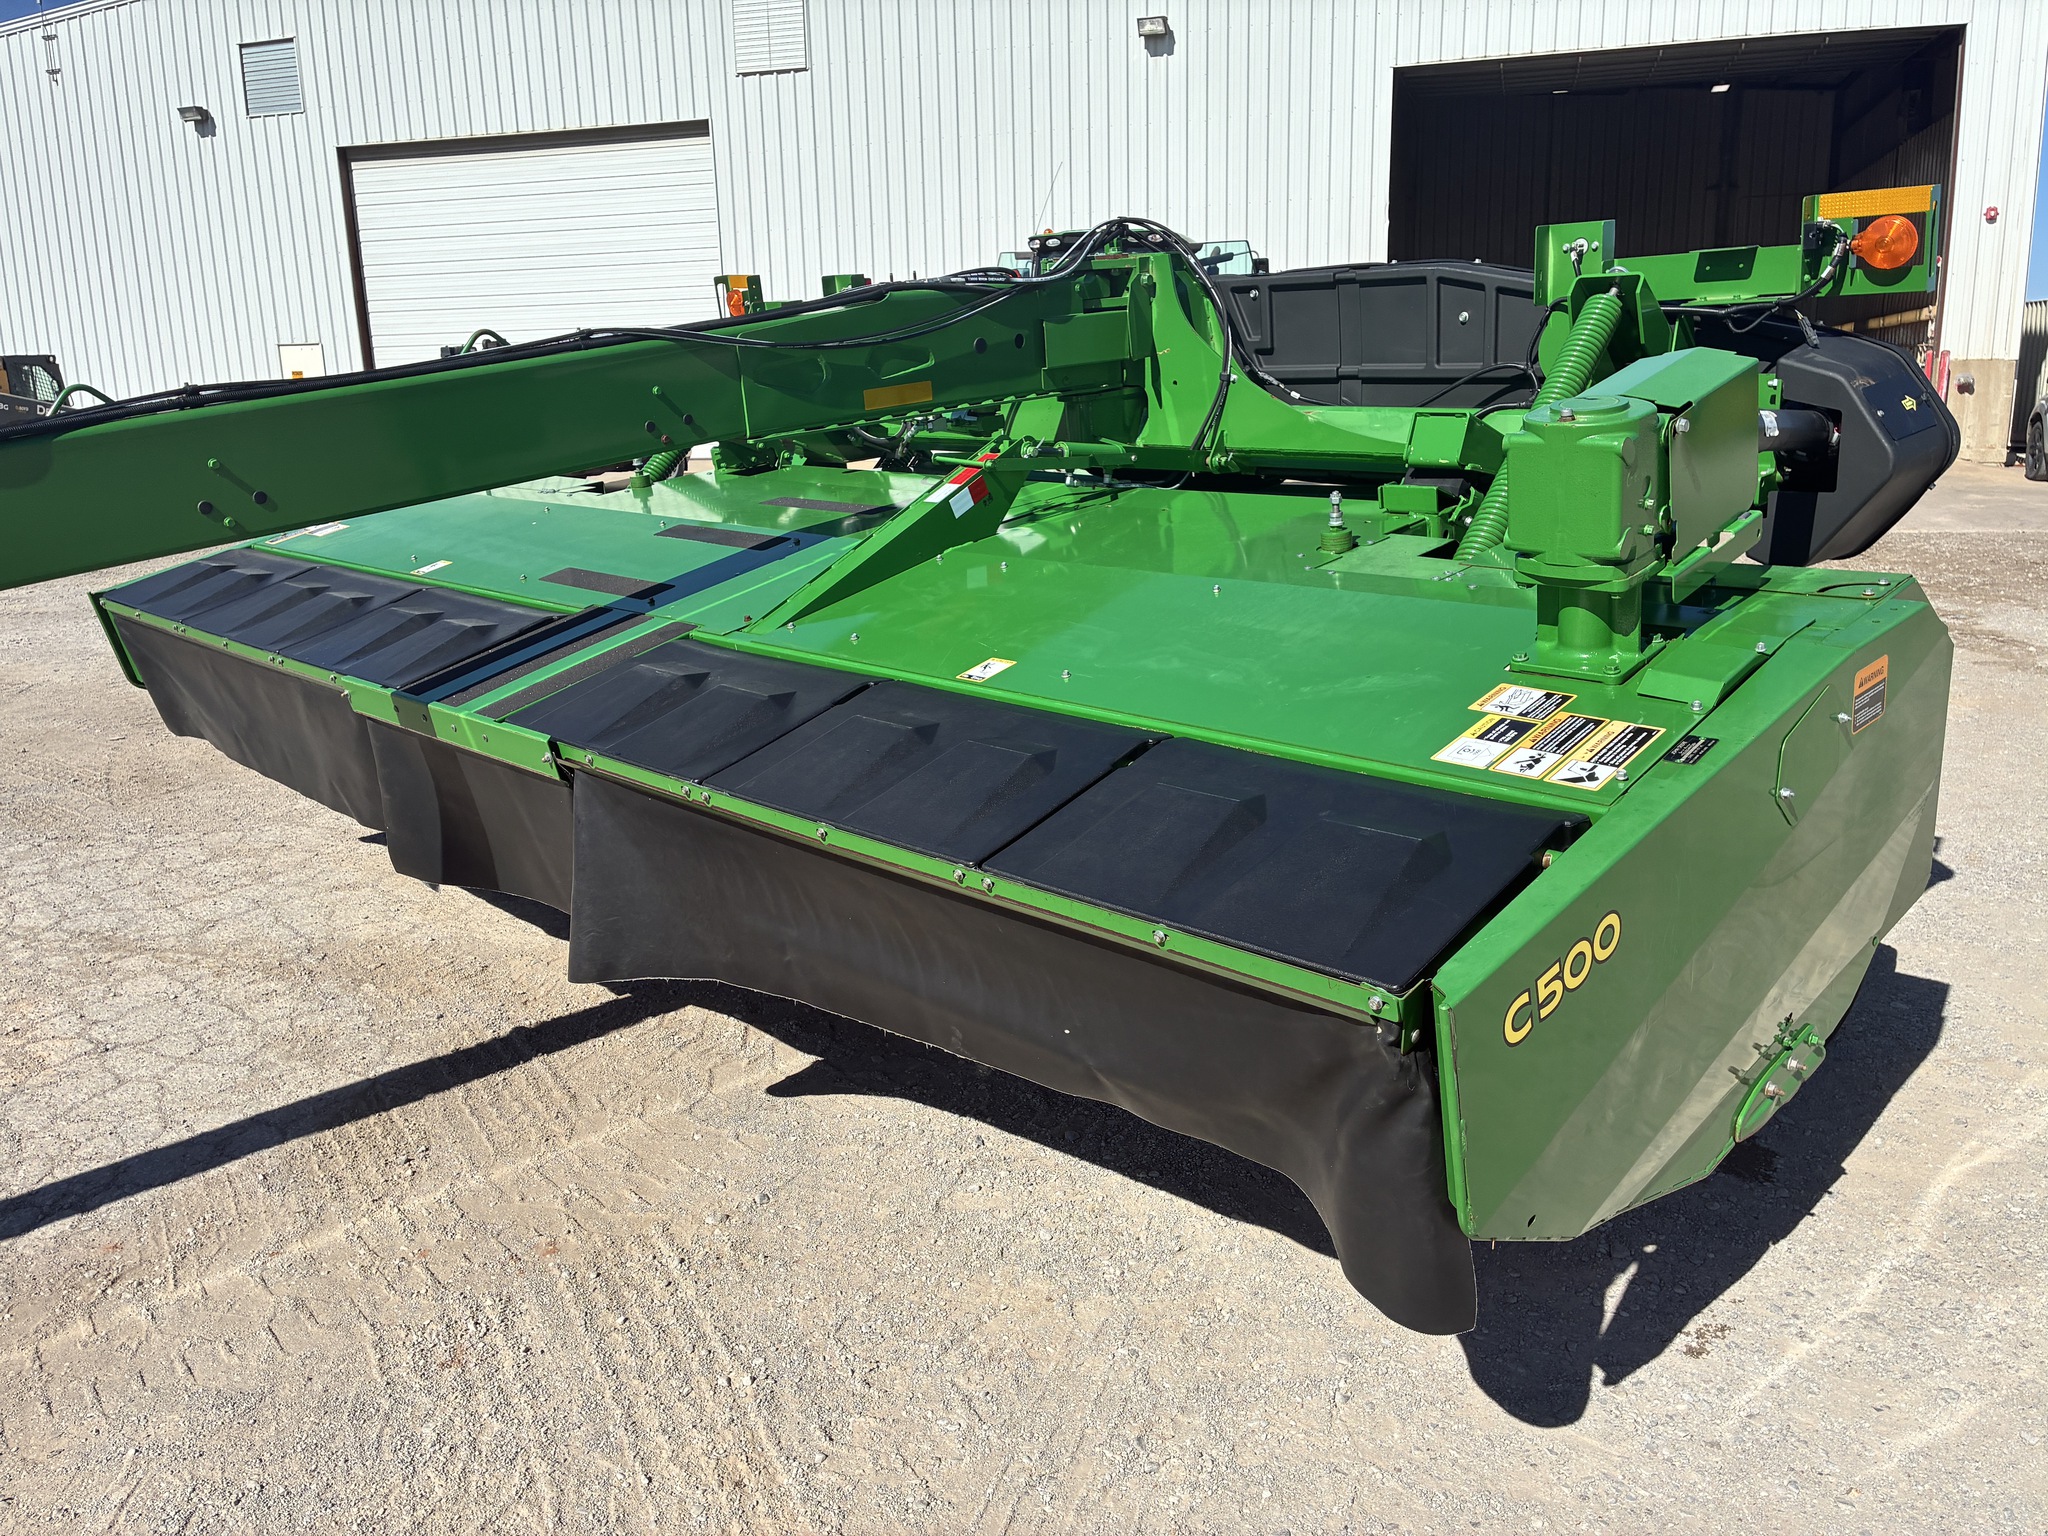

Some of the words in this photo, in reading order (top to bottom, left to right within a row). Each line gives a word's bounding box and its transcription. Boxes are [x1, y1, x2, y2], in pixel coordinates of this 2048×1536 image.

[1863, 666, 1885, 685] WARNING
[1482, 687, 1507, 704] WARNING
[1474, 717, 1496, 734] CAUTION
[1532, 718, 1562, 741] WARNING
[1591, 731, 1615, 750] WARNING
[1502, 909, 1622, 1048] C500
